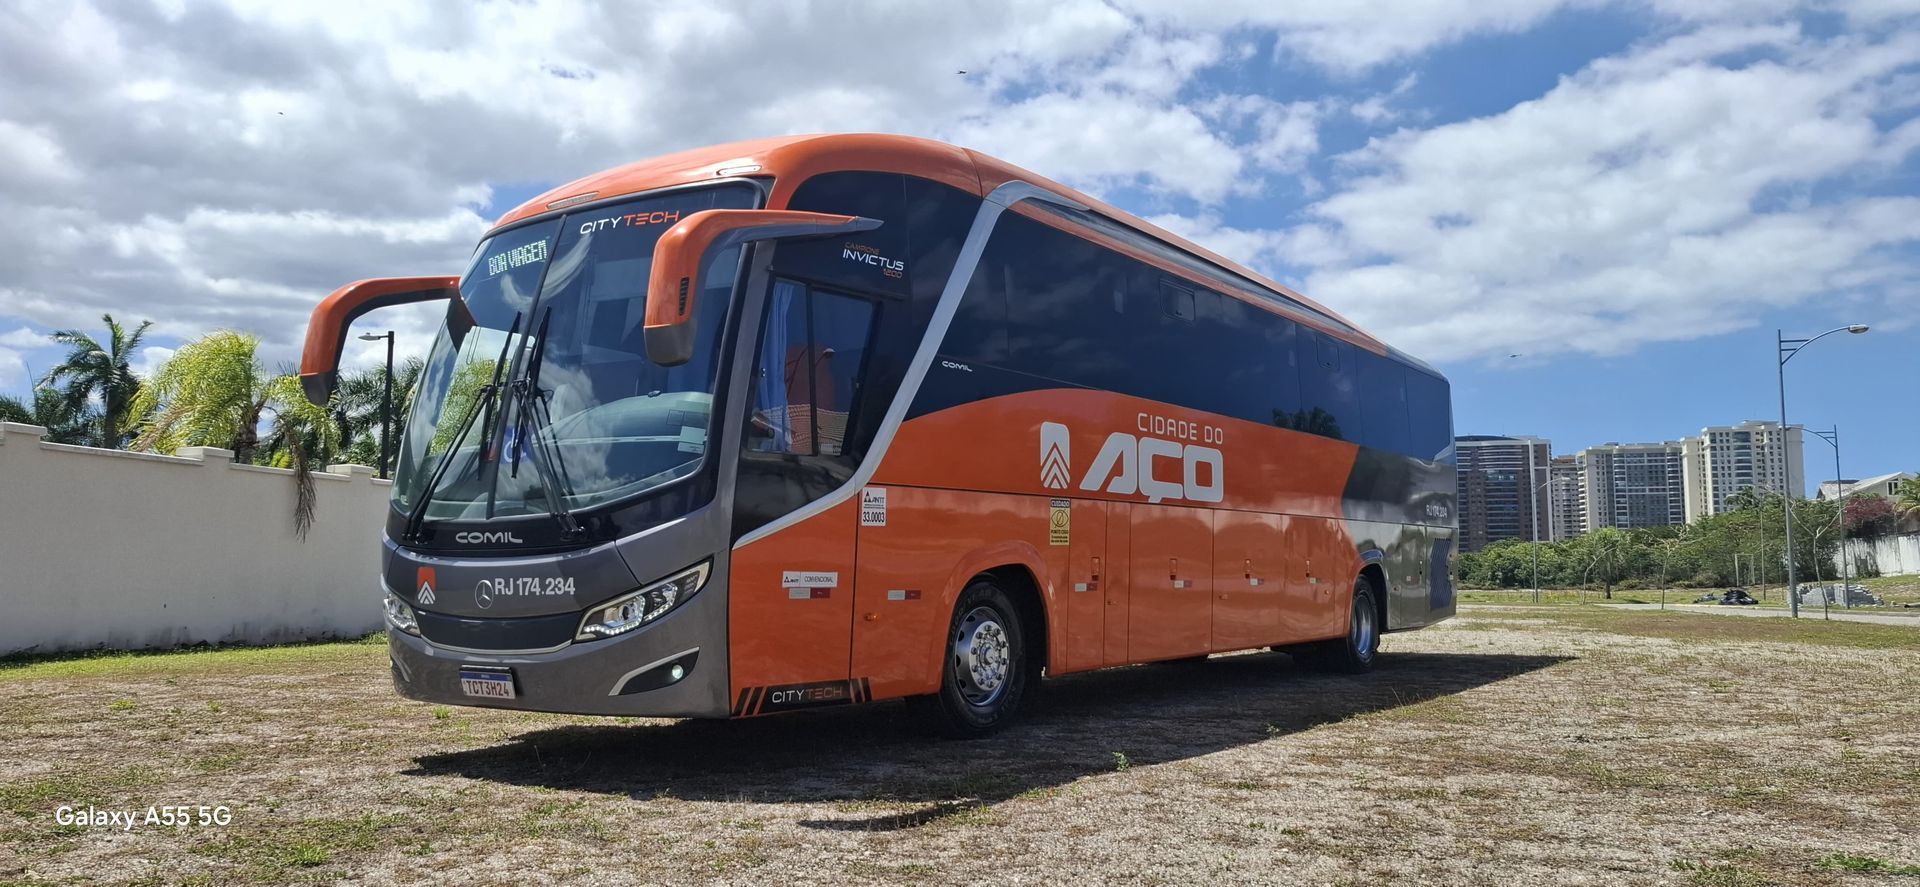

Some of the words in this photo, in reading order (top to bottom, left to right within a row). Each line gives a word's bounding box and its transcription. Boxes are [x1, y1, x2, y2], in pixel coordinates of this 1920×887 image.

[488, 253, 508, 276] BOA
[508, 240, 547, 269] VIAGEM
[842, 248, 905, 271] INVICTUS
[941, 360, 973, 372] COMIL
[1137, 412, 1198, 441] CIDADE
[1204, 425, 1223, 445] DO
[1079, 431, 1224, 504] AÇO
[455, 531, 523, 544] COMIL
[494, 577, 514, 596] RJ
[516, 577, 576, 596] 174.234
[466, 680, 510, 697] TCT3H24
